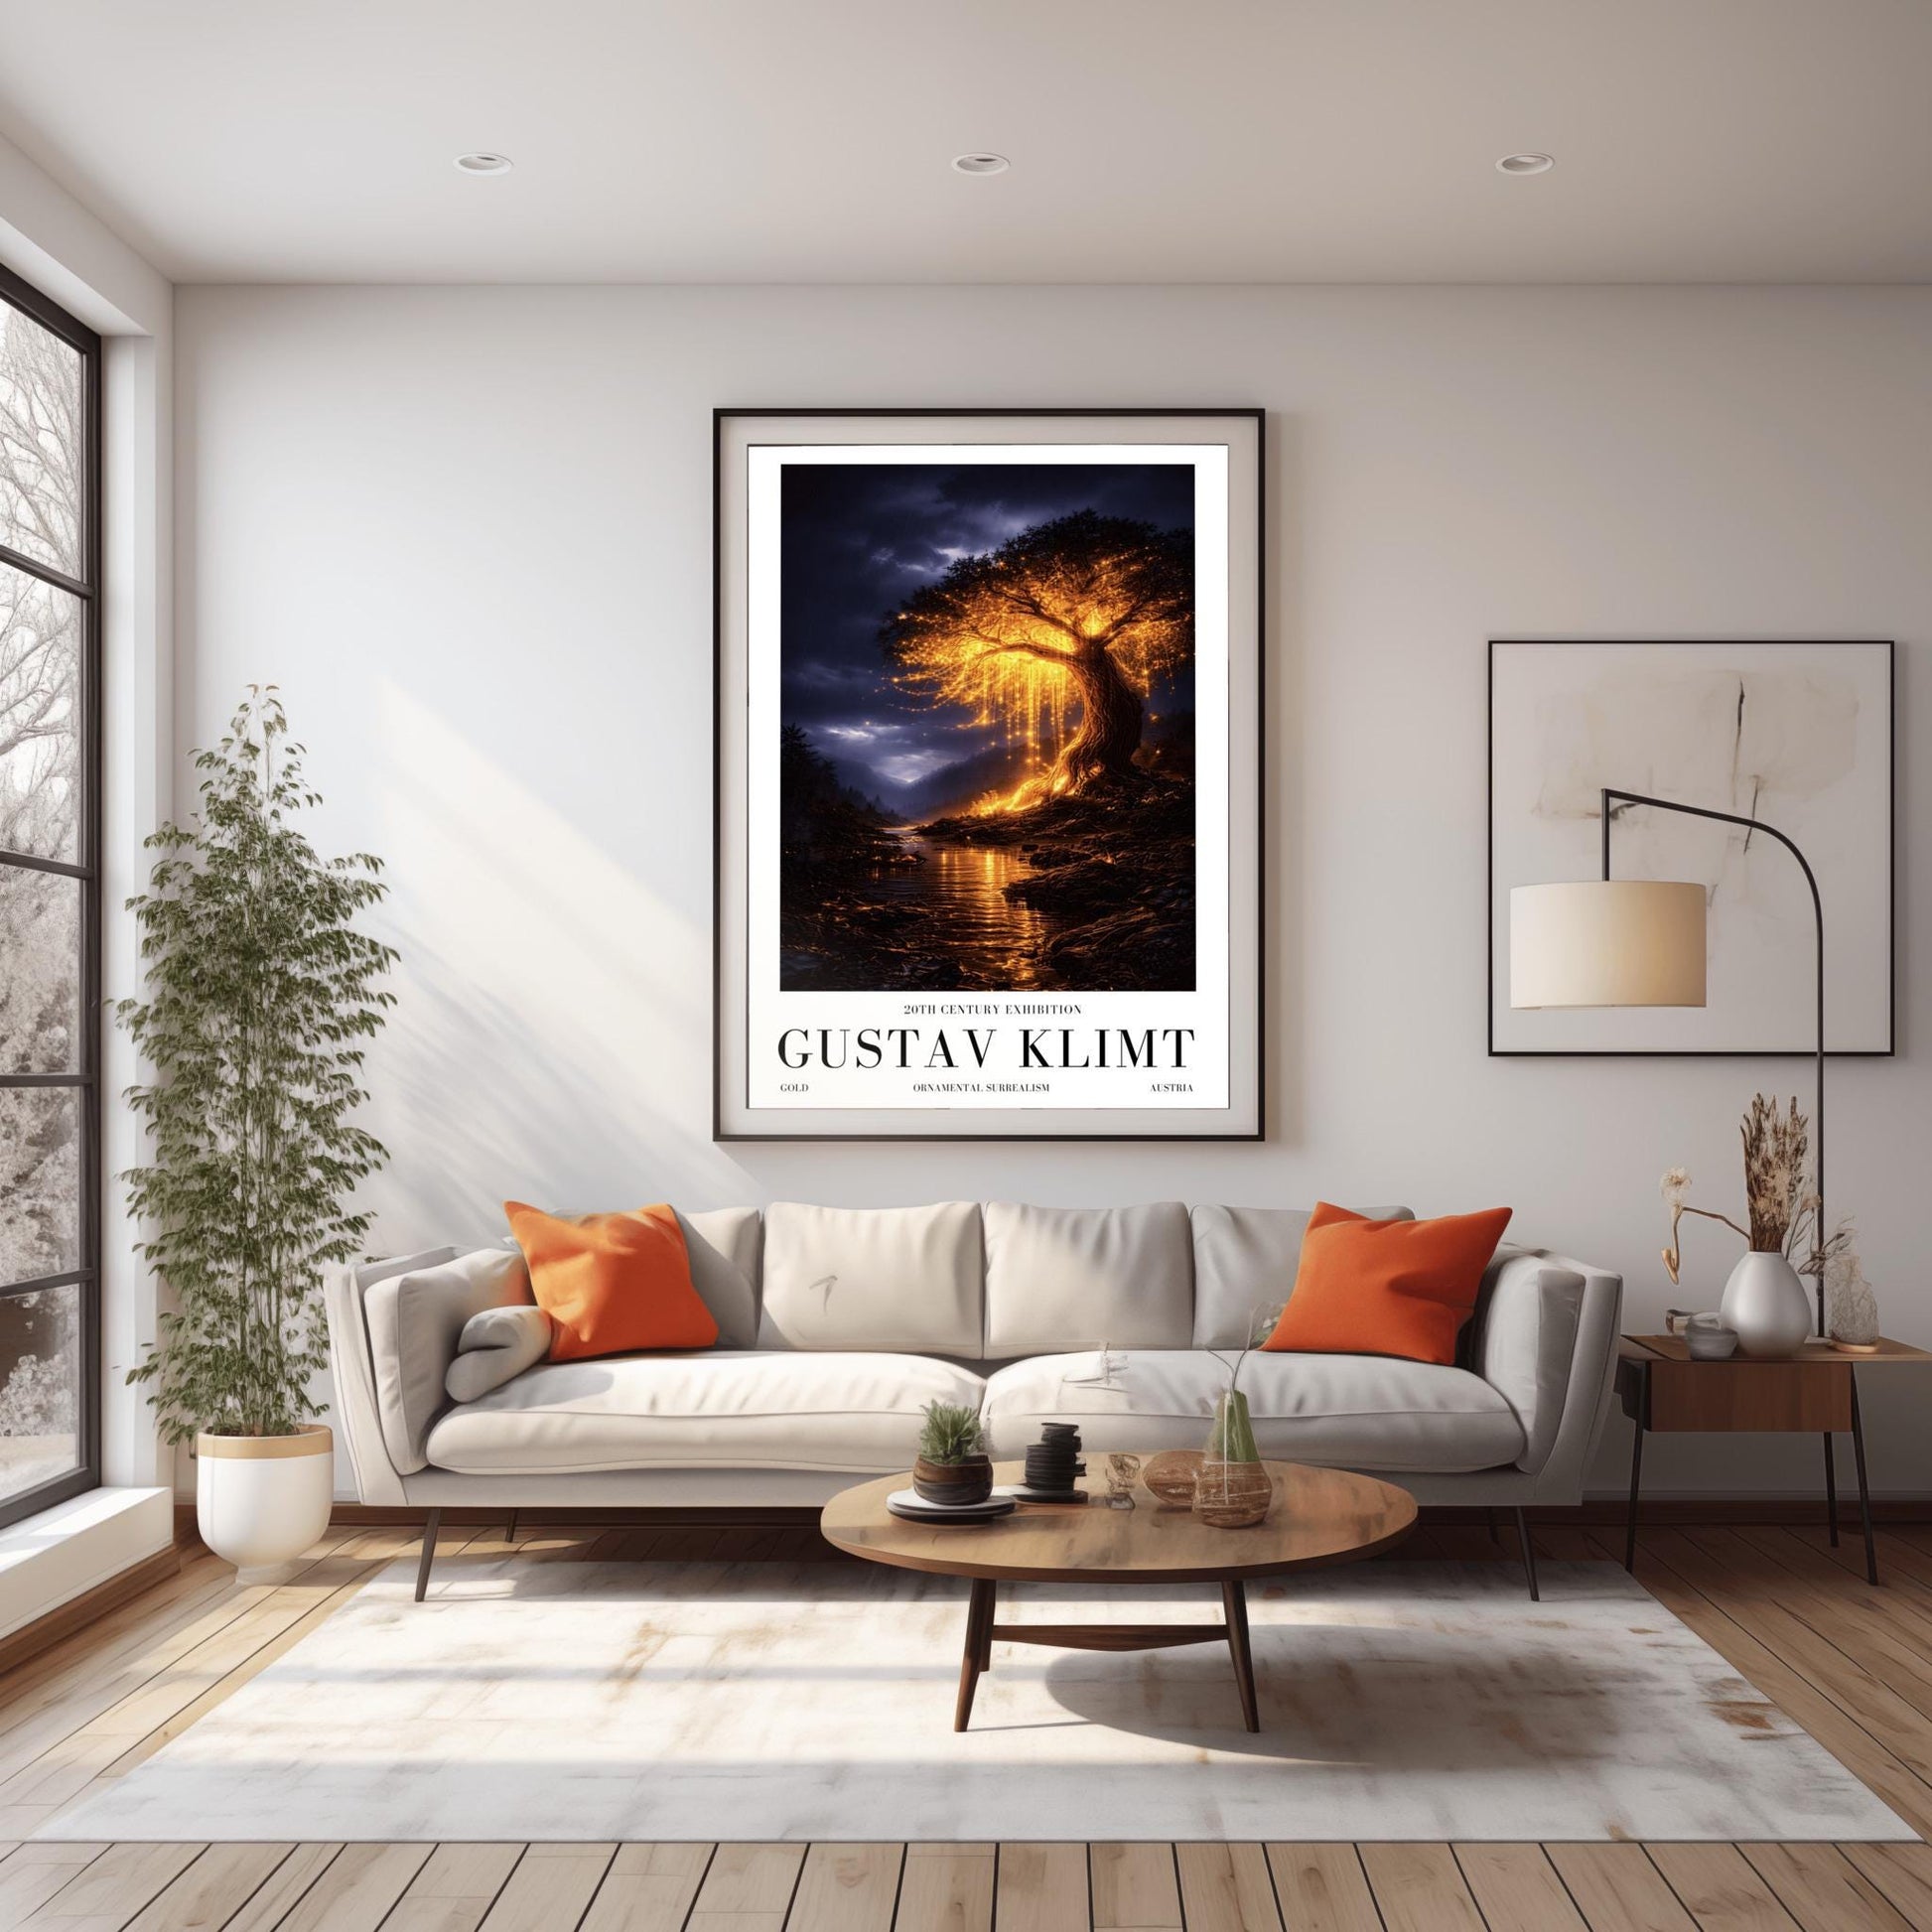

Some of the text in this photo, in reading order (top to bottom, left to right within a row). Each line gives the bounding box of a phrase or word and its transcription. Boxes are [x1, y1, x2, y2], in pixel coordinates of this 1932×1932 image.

[903, 1004, 1082, 1015] 20TH CENTURY EXHIBITION
[777, 1029, 1195, 1069] GUSTAV KLIMT
[779, 1083, 809, 1092] GOLD
[912, 1083, 1050, 1092] ORNAMENTAL SURREALISM
[1150, 1083, 1194, 1092] AUSTRIA
